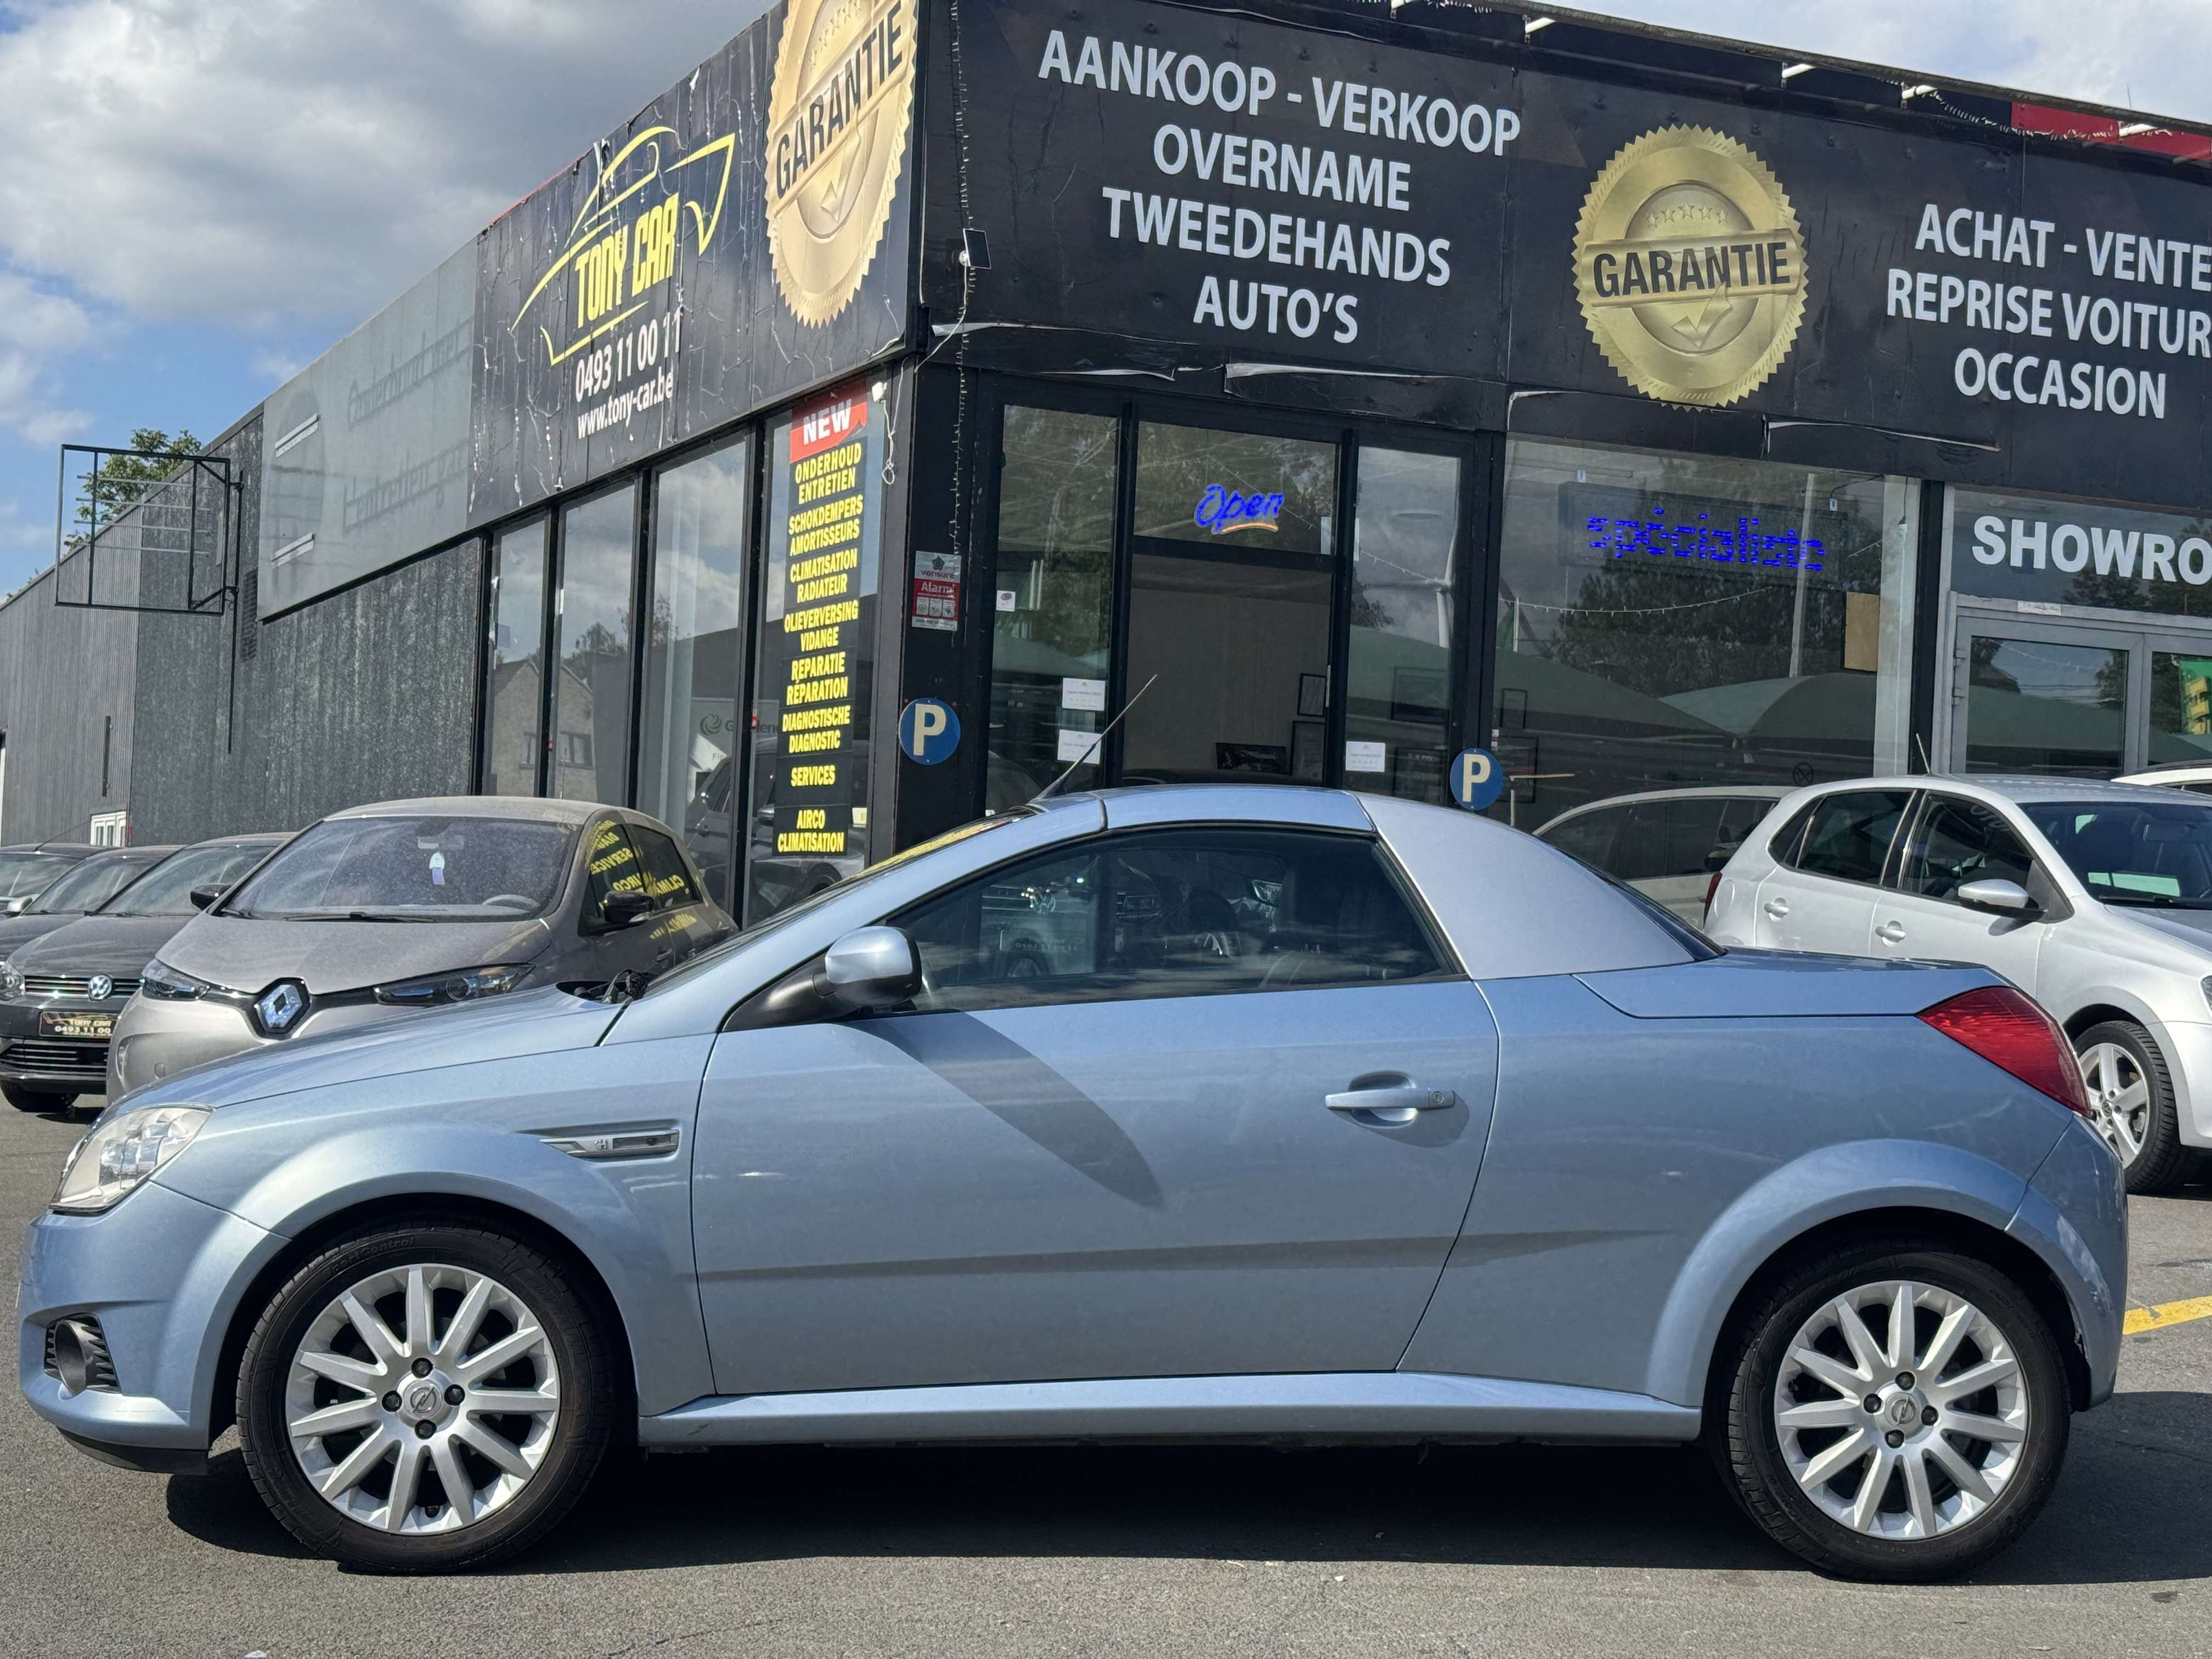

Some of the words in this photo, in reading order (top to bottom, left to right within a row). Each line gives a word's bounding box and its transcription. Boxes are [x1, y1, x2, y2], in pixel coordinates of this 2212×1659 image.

[776, 4, 904, 198] GARANTIE
[1038, 30, 1276, 116] AANKOOP
[1287, 92, 1302, 103] -
[1312, 77, 1520, 156] VERKOOP
[1154, 124, 1411, 212] OVERNAME
[575, 224, 629, 329] TONY
[631, 192, 679, 297] CAR
[1102, 187, 1451, 287] TWEEDEHANDS
[1915, 204, 2055, 268] ACHAT
[2063, 244, 2077, 253] -
[2086, 228, 2212, 292] VENTE
[1592, 241, 1791, 299] GARANTIE
[1193, 276, 1358, 345] AUTO'S
[1887, 268, 2053, 337] REPRISE
[2062, 293, 2211, 358] VOITUR
[576, 345, 612, 403] 0493
[617, 337, 633, 382] 11
[637, 319, 658, 371] 00
[663, 307, 681, 358] 11
[578, 366, 674, 439] www.tony-car.be
[1955, 347, 2166, 419] OCCASION
[803, 399, 852, 445] NEW
[795, 442, 862, 484] ONDERHOUD
[798, 467, 856, 504] ENTRETIEN
[789, 494, 864, 535] SCHOKDEMPERS
[1195, 484, 1284, 533] Open
[789, 518, 860, 556] AMORTISSEURS
[1972, 515, 2212, 585] SHOWRO
[790, 548, 857, 583] CLIMATISATION
[797, 573, 848, 603] RADIATEUR
[784, 600, 859, 634] OLIEVERVERSING
[800, 626, 839, 652] VIDANGE
[791, 651, 846, 681] REPARATIE
[786, 676, 848, 706] RÉPARATION
[782, 705, 851, 732] DIAGNOSTISCHE
[788, 730, 841, 753] DIAGNOSTIC
[913, 703, 946, 757] P
[790, 764, 836, 787] SERVICES
[1462, 753, 1491, 802] P
[777, 832, 844, 853] CLIMATISATION
[796, 809, 826, 830] AIRCO
